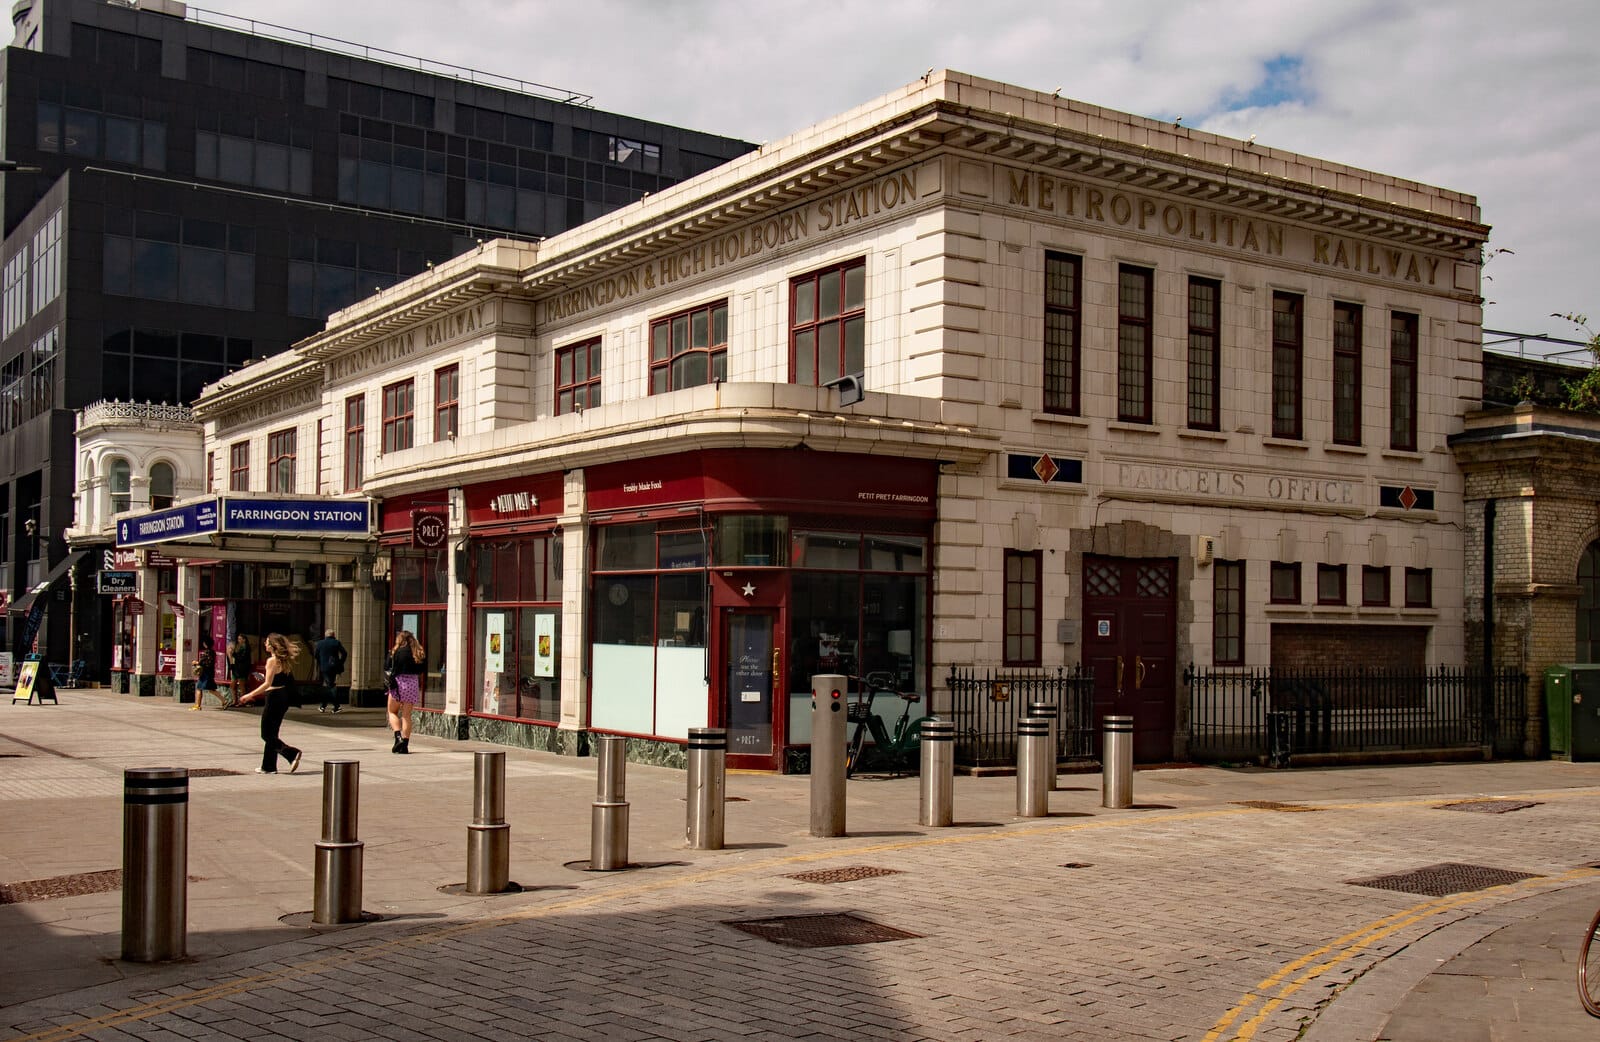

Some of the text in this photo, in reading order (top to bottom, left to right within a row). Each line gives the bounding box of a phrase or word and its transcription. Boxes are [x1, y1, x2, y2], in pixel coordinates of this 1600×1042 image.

[1008, 169, 1440, 286] METROPOLITAN RAILWAY
[547, 167, 918, 322] FARRINGDON & HIGH HOLBORN STATION
[329, 303, 486, 382] METROPOLITAN RAILWAY
[650, 479, 663, 490] Food
[1267, 477, 1354, 504] OFFICE
[513, 491, 530, 511] PRET
[857, 492, 929, 503] PETIT PRET FARRINGDON
[230, 509, 310, 521] FARRINGDON
[313, 510, 363, 522] STATION
[139, 518, 166, 536] FARRINGDON
[165, 514, 185, 531] STATION
[422, 525, 440, 537] PRET
[111, 577, 126, 586] Dry
[101, 584, 136, 593] Cleaners
[741, 735, 755, 745] PRET
